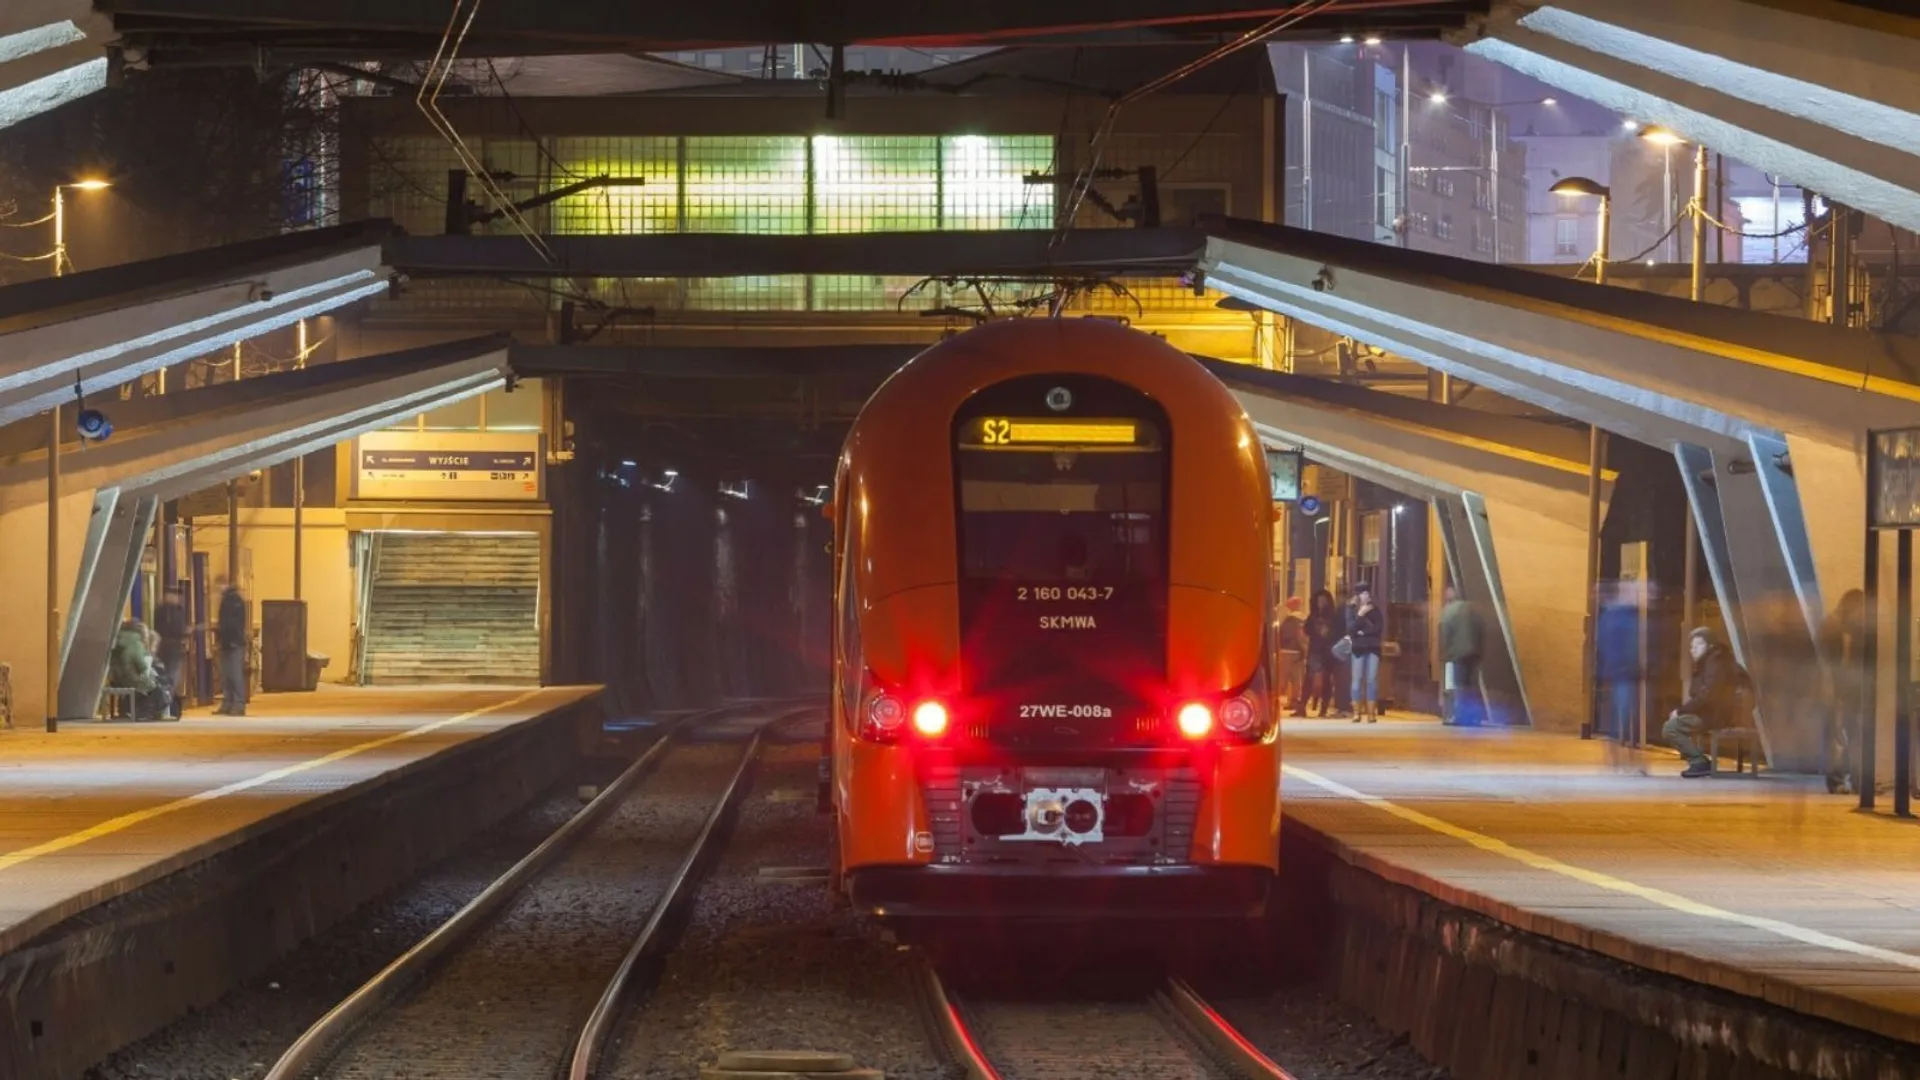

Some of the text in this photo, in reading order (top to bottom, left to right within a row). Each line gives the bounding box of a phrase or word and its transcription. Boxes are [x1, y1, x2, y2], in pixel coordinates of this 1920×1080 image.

[983, 418, 1010, 444] S2
[429, 456, 469, 465] WYJŚCIE
[1018, 587, 1114, 601] 2 160 043-7
[1040, 616, 1096, 629] SKMWA
[1020, 705, 1112, 718] 27WE-008a
